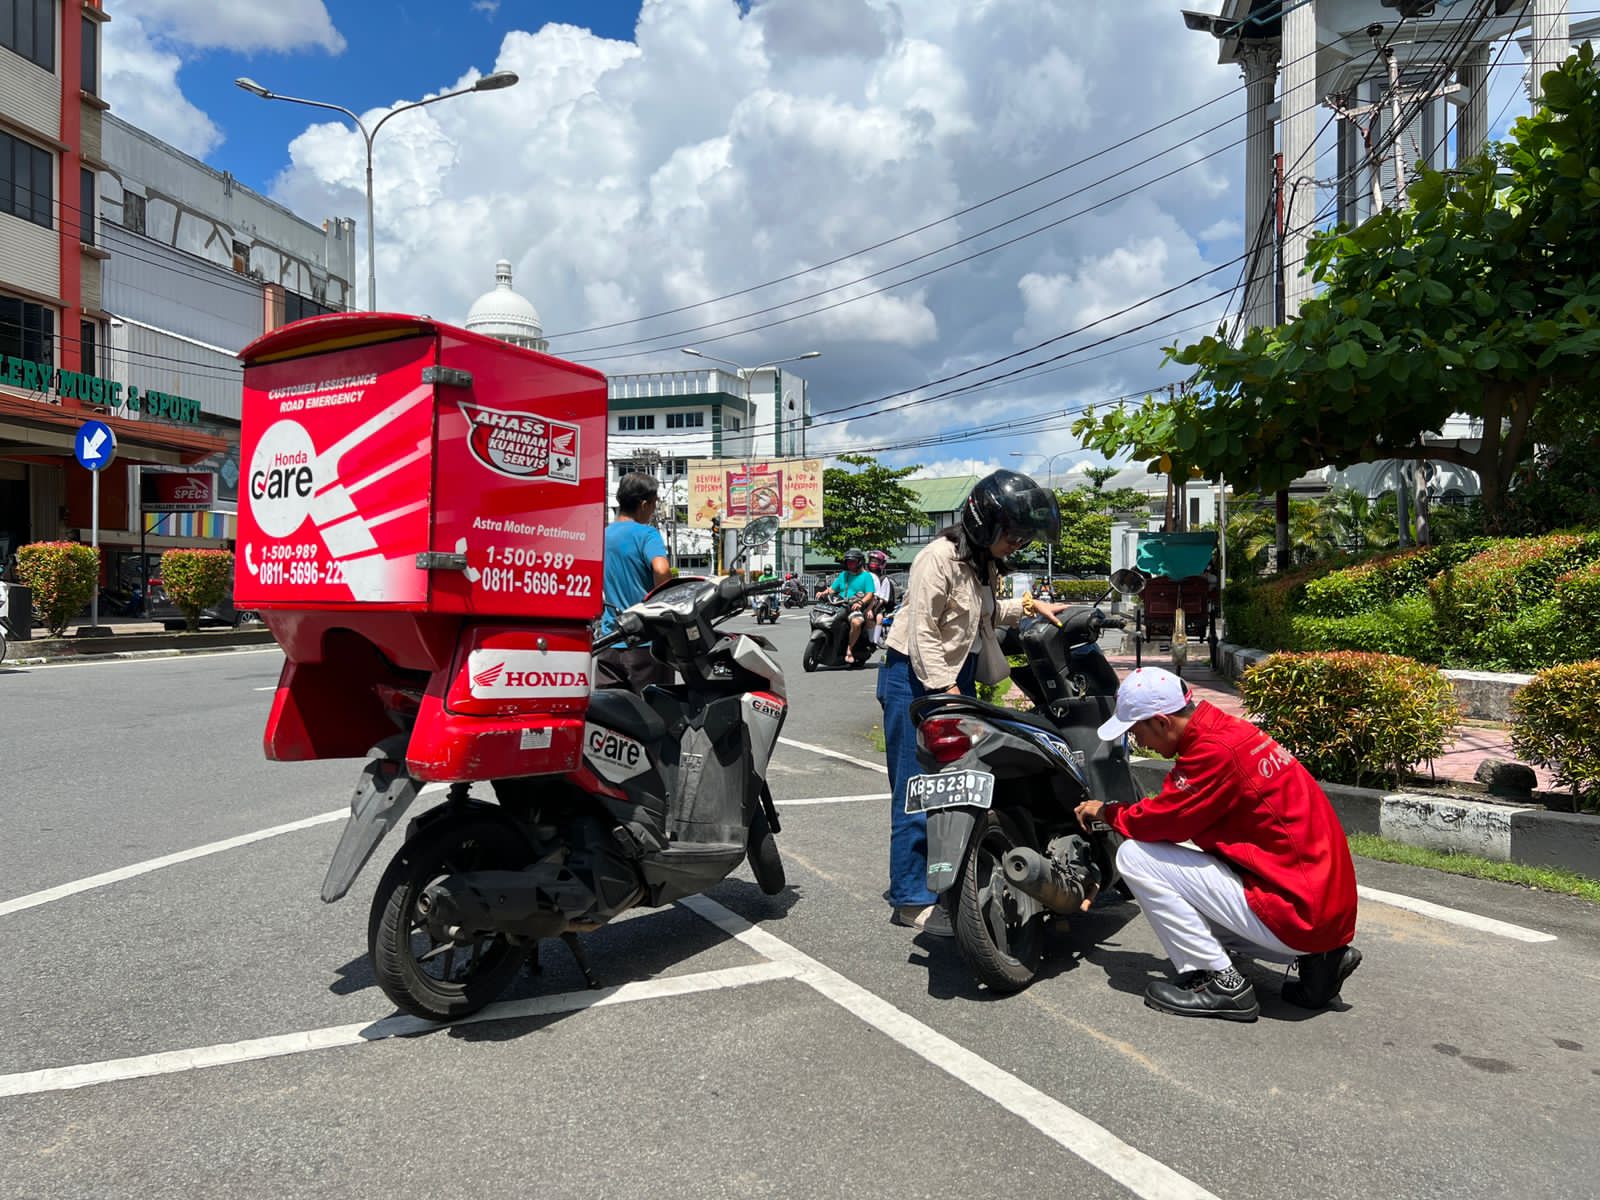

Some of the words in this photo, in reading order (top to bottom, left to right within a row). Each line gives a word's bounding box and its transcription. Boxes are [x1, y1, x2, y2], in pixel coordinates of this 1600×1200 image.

[59, 368, 123, 408] MUSIC
[127, 385, 140, 412] &
[147, 389, 201, 424] SPORT
[268, 382, 316, 400] CUSTOMER
[317, 373, 377, 392] ASSISTANCE
[279, 398, 304, 413] ROAD
[305, 390, 365, 409] EMERGENCY
[475, 411, 545, 435] AHASS
[488, 438, 548, 459] KUALITAS
[491, 428, 548, 449] JAMINAN
[274, 451, 308, 467] Honda
[503, 452, 546, 469] SERVIS
[173, 488, 209, 499] SPECS
[473, 516, 502, 531] Astra
[503, 520, 536, 536] Motor
[537, 525, 587, 541] Pattimura
[261, 544, 318, 561] 1-500-989
[486, 546, 575, 570] 1-500-989
[481, 567, 592, 597] 0811-5696-222
[504, 671, 589, 687] HONDA
[910, 780, 925, 797] KB
[926, 775, 965, 794] 5623
